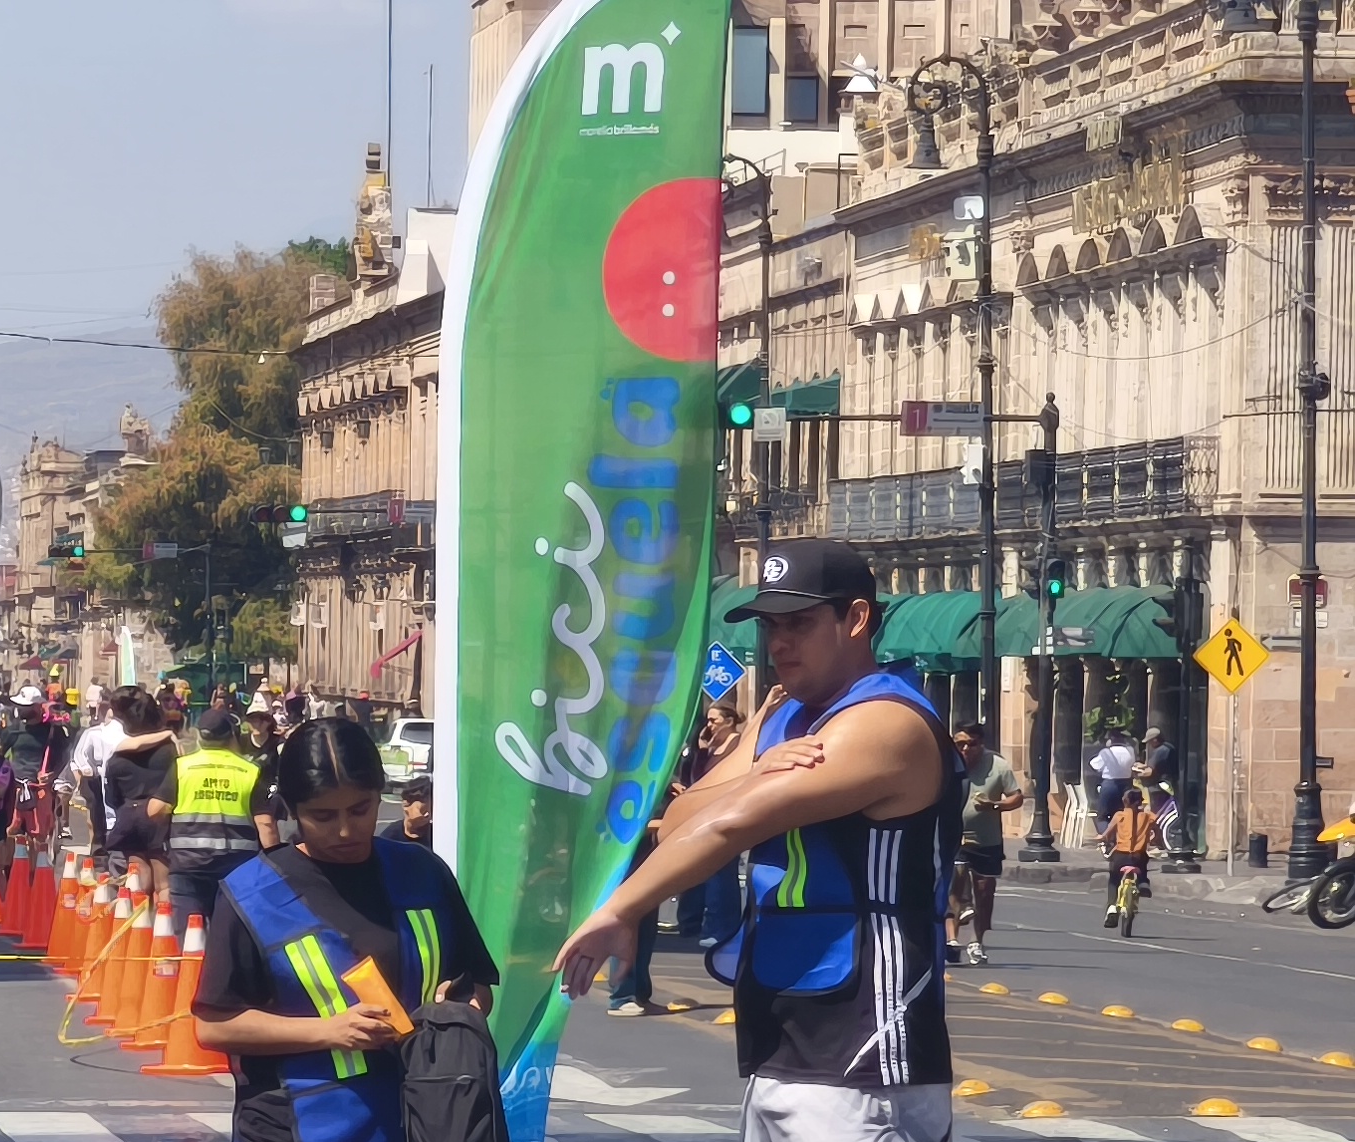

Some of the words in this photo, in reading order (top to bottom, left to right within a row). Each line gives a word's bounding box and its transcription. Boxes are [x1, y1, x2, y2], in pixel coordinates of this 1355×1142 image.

[581, 42, 665, 116] m
[912, 408, 921, 429] 1
[494, 480, 609, 797] bici
